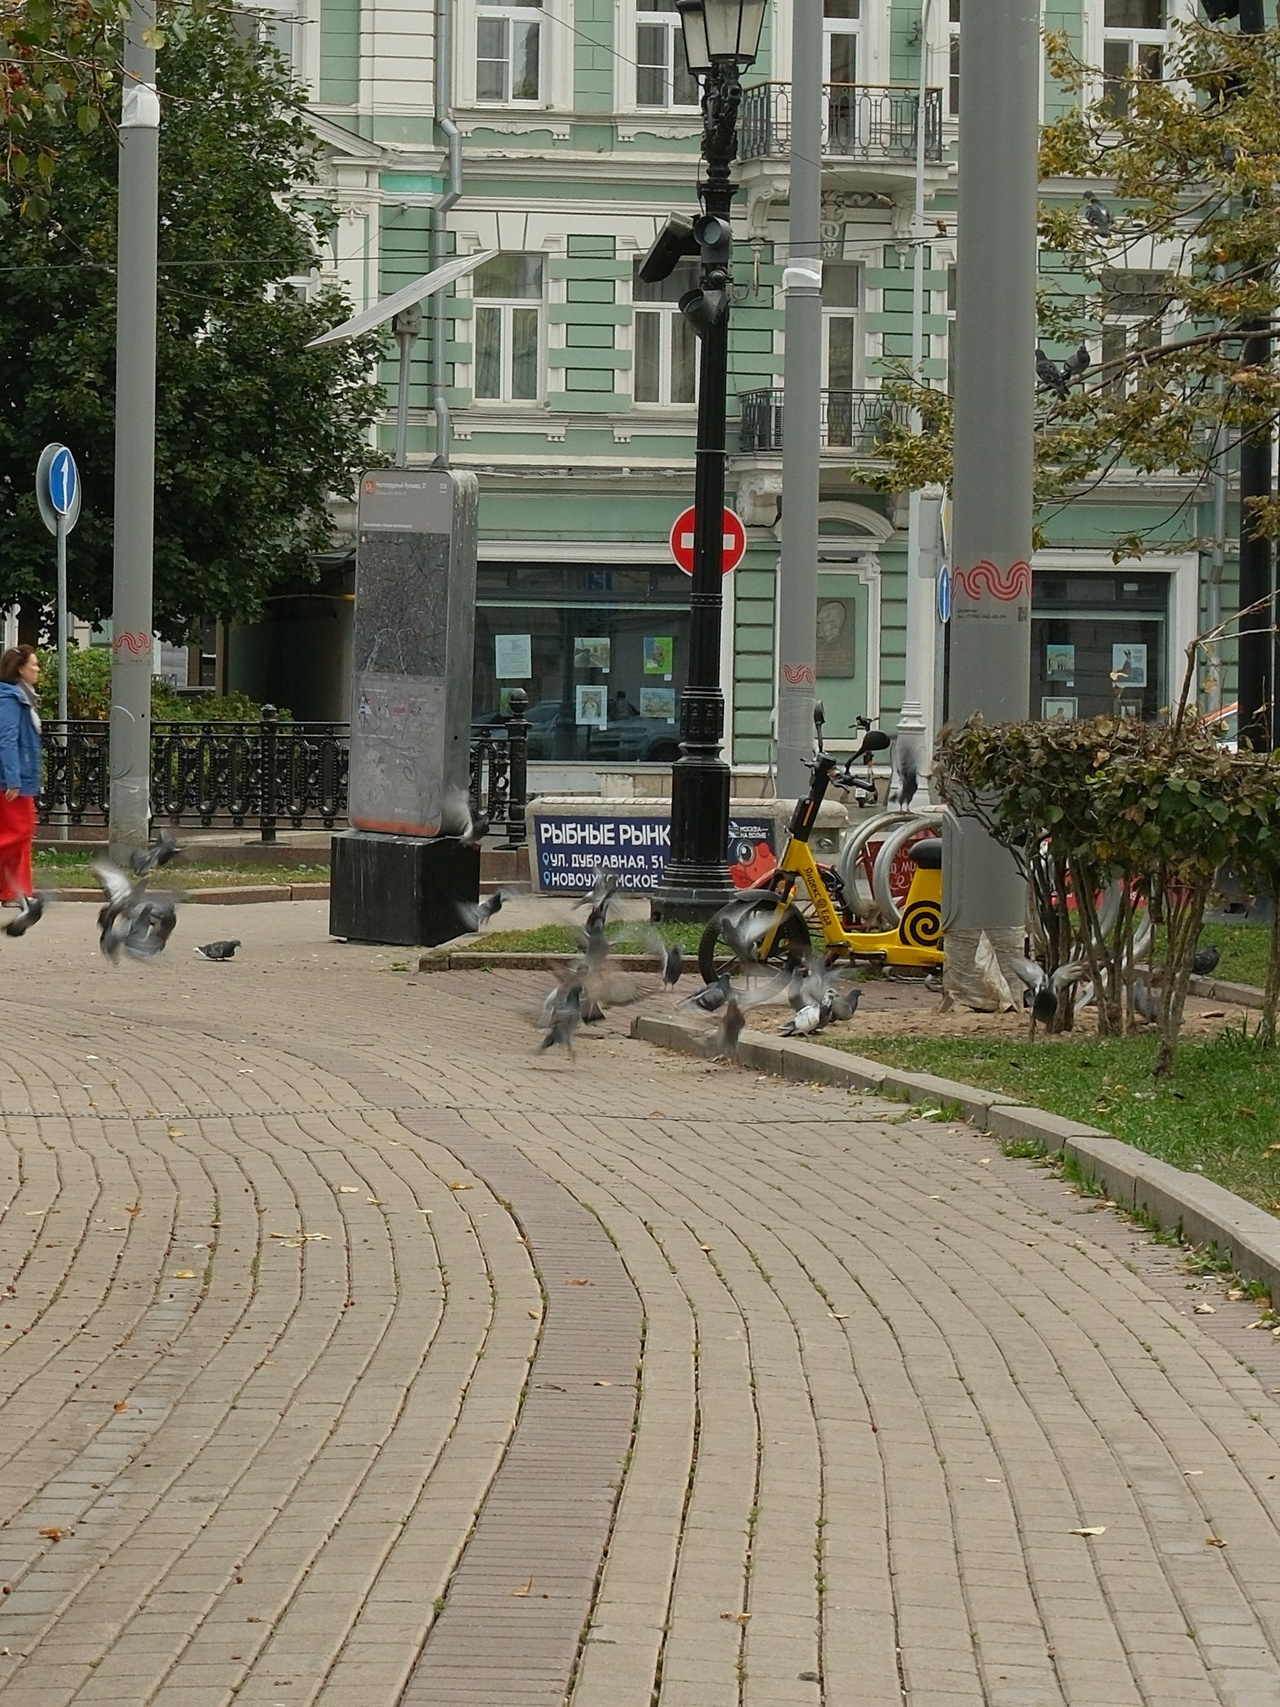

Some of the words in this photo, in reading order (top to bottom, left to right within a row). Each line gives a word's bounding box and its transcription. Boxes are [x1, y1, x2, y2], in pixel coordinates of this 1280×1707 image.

[540, 822, 616, 846] РЫБНЫЕ
[618, 824, 672, 847] РЫНК
[549, 853, 569, 867] УЛ.
[571, 853, 649, 870] ДУБРАВНАЯ,
[550, 872, 659, 888] НОВОУХМСКОЕ
[803, 866, 822, 899] Яндекс
[820, 908, 832, 926] Еда
